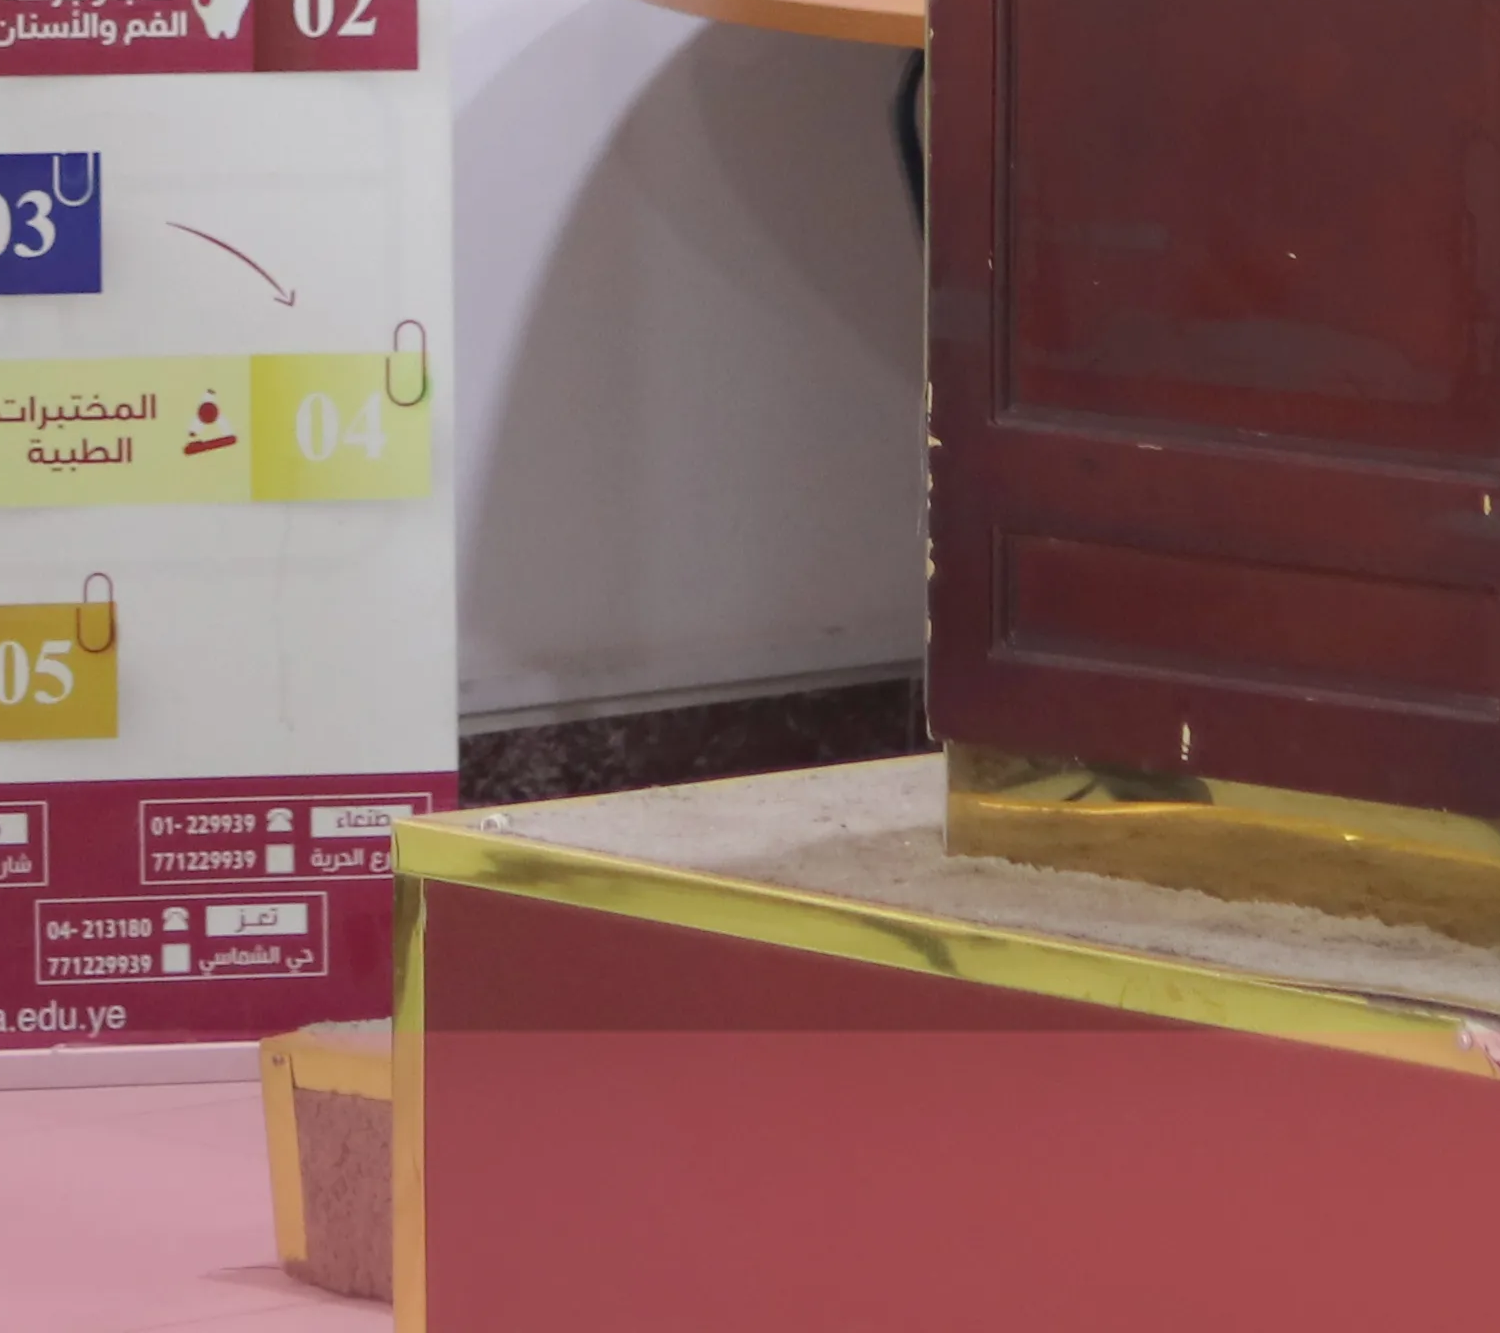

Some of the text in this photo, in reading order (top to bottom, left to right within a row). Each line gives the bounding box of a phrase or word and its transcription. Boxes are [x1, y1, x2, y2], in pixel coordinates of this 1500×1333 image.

[122, 10, 188, 46] الفم
[294, 390, 388, 463] 04
[26, 436, 133, 473] الطبية
[186, 813, 257, 835] 229939
[151, 849, 257, 872] 771229939
[310, 847, 366, 873] الحرية
[81, 917, 153, 939] 213180
[46, 953, 153, 976] 771229939
[284, 947, 314, 974] حي
